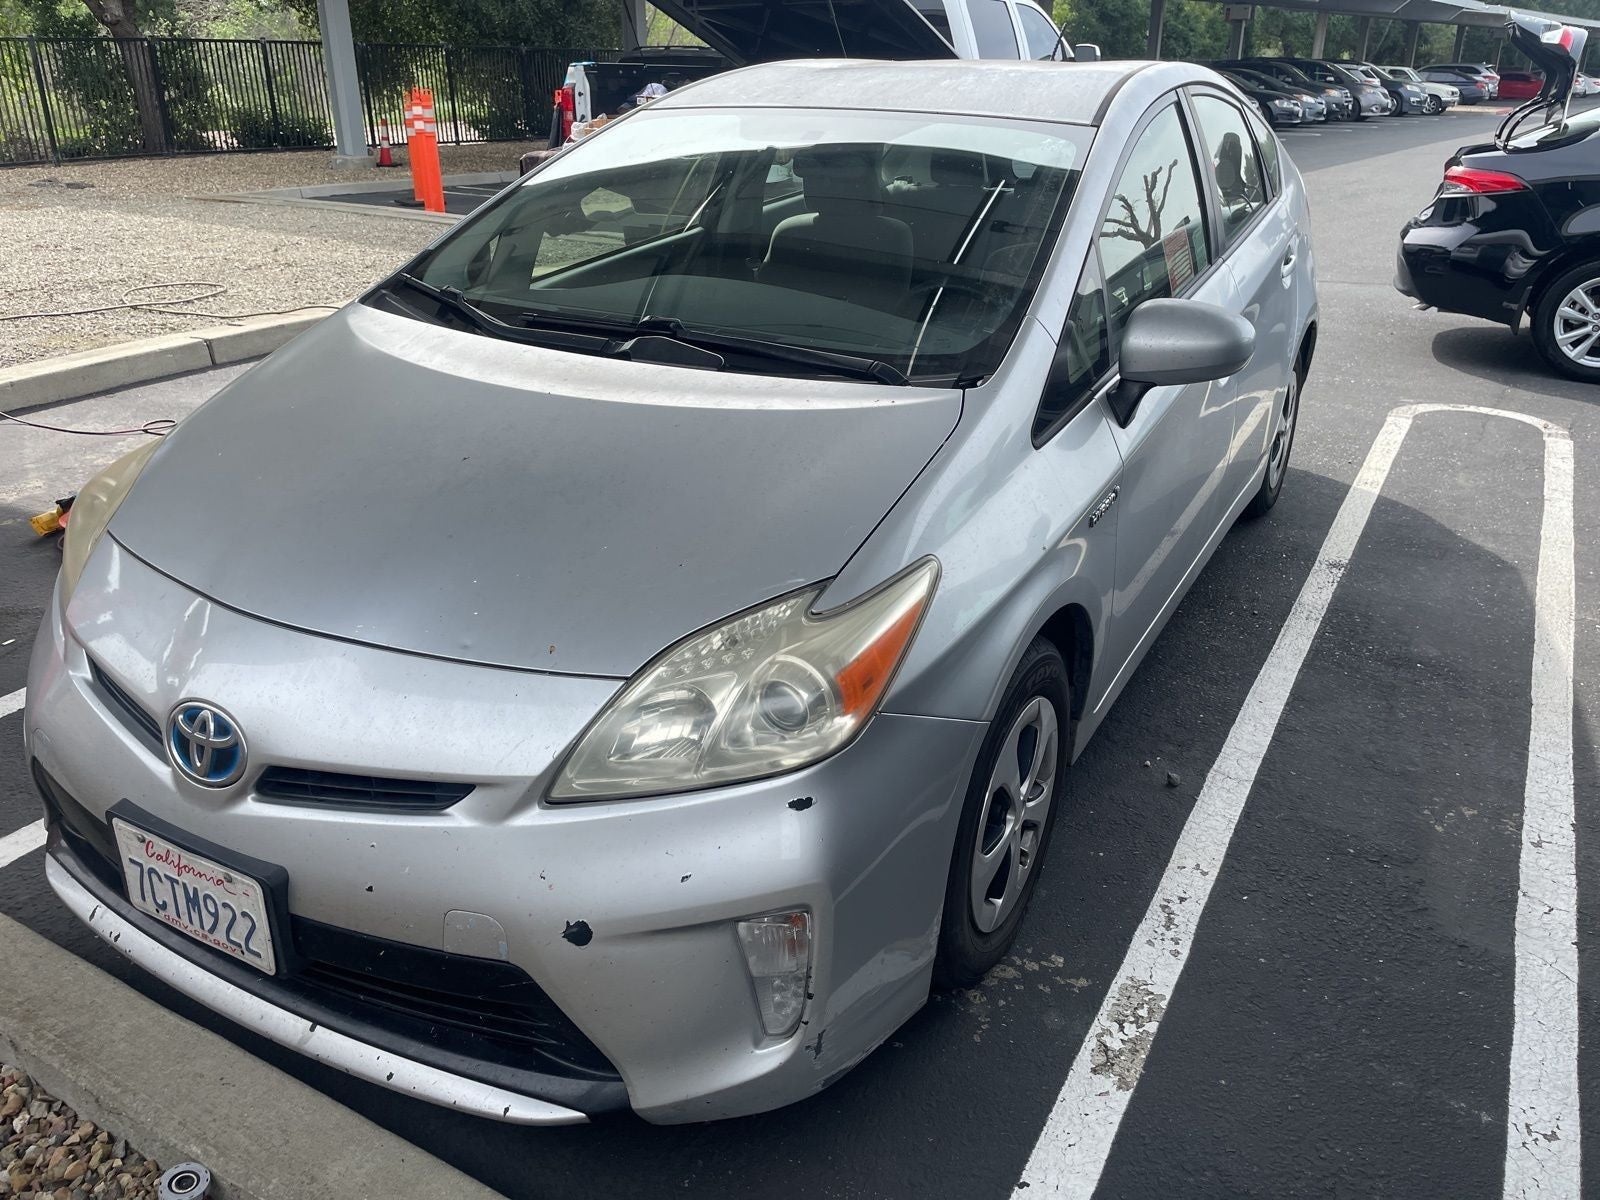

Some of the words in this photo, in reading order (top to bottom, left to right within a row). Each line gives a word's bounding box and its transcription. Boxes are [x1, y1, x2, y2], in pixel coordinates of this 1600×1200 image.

[1088, 485, 1120, 528] HYBRID
[144, 840, 237, 896] California
[128, 857, 262, 959] 7CTM922
[163, 912, 237, 954] dmv.ca.gov
